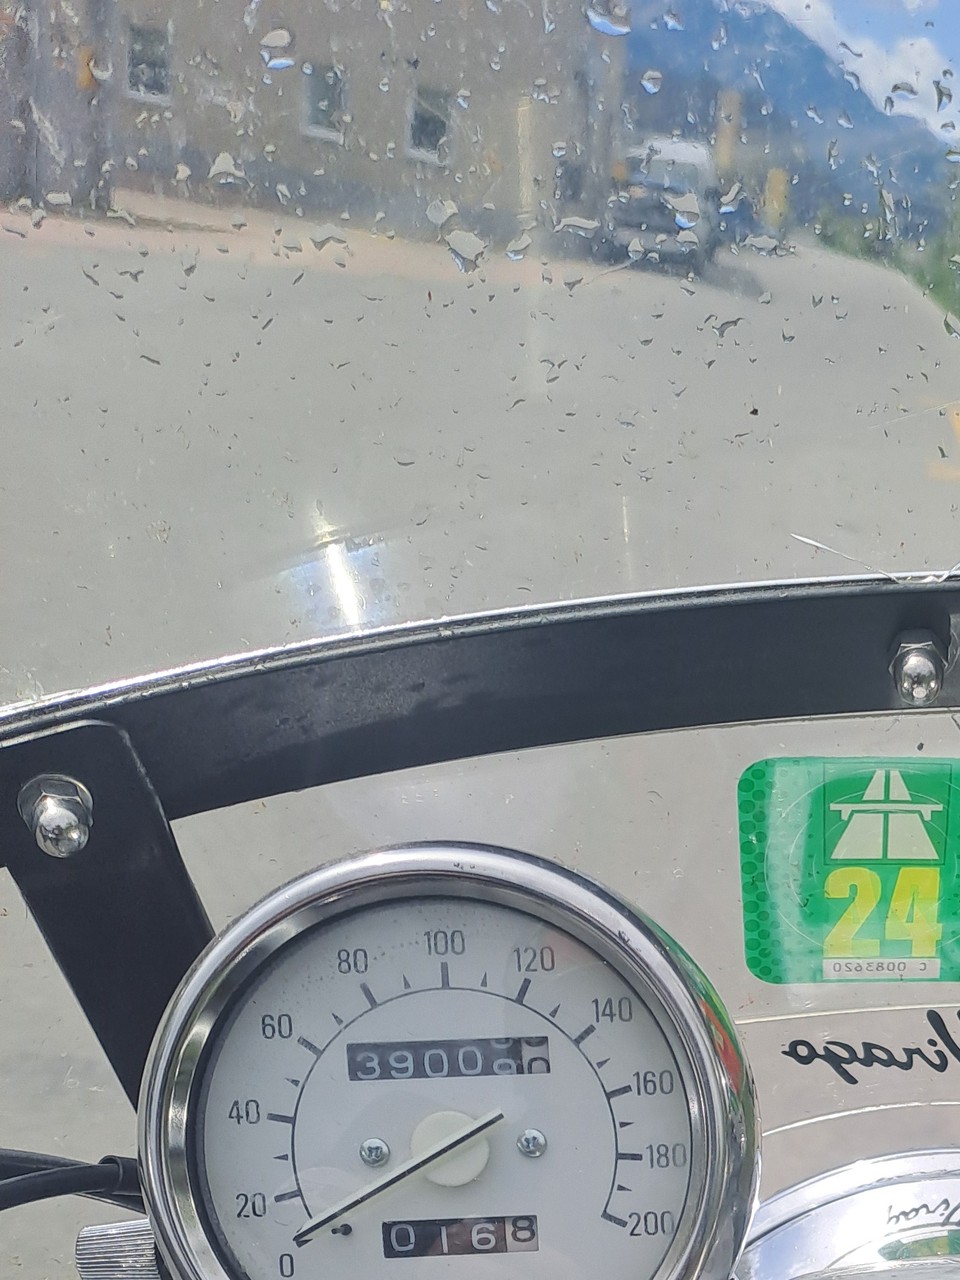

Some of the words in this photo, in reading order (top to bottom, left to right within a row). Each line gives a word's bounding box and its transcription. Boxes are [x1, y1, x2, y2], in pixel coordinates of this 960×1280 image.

[823, 866, 943, 958] 24
[423, 928, 467, 956] 100
[337, 948, 369, 975] 80
[513, 945, 556, 973] 120
[592, 996, 633, 1024] 140
[261, 1013, 293, 1040] 60
[632, 1069, 674, 1096] 160
[228, 1099, 260, 1126] 40
[646, 1143, 687, 1169] 180
[235, 1193, 267, 1219] 20
[390, 1216, 536, 1254] 0168
[628, 1211, 675, 1237] 200
[279, 1253, 296, 1279] 0
